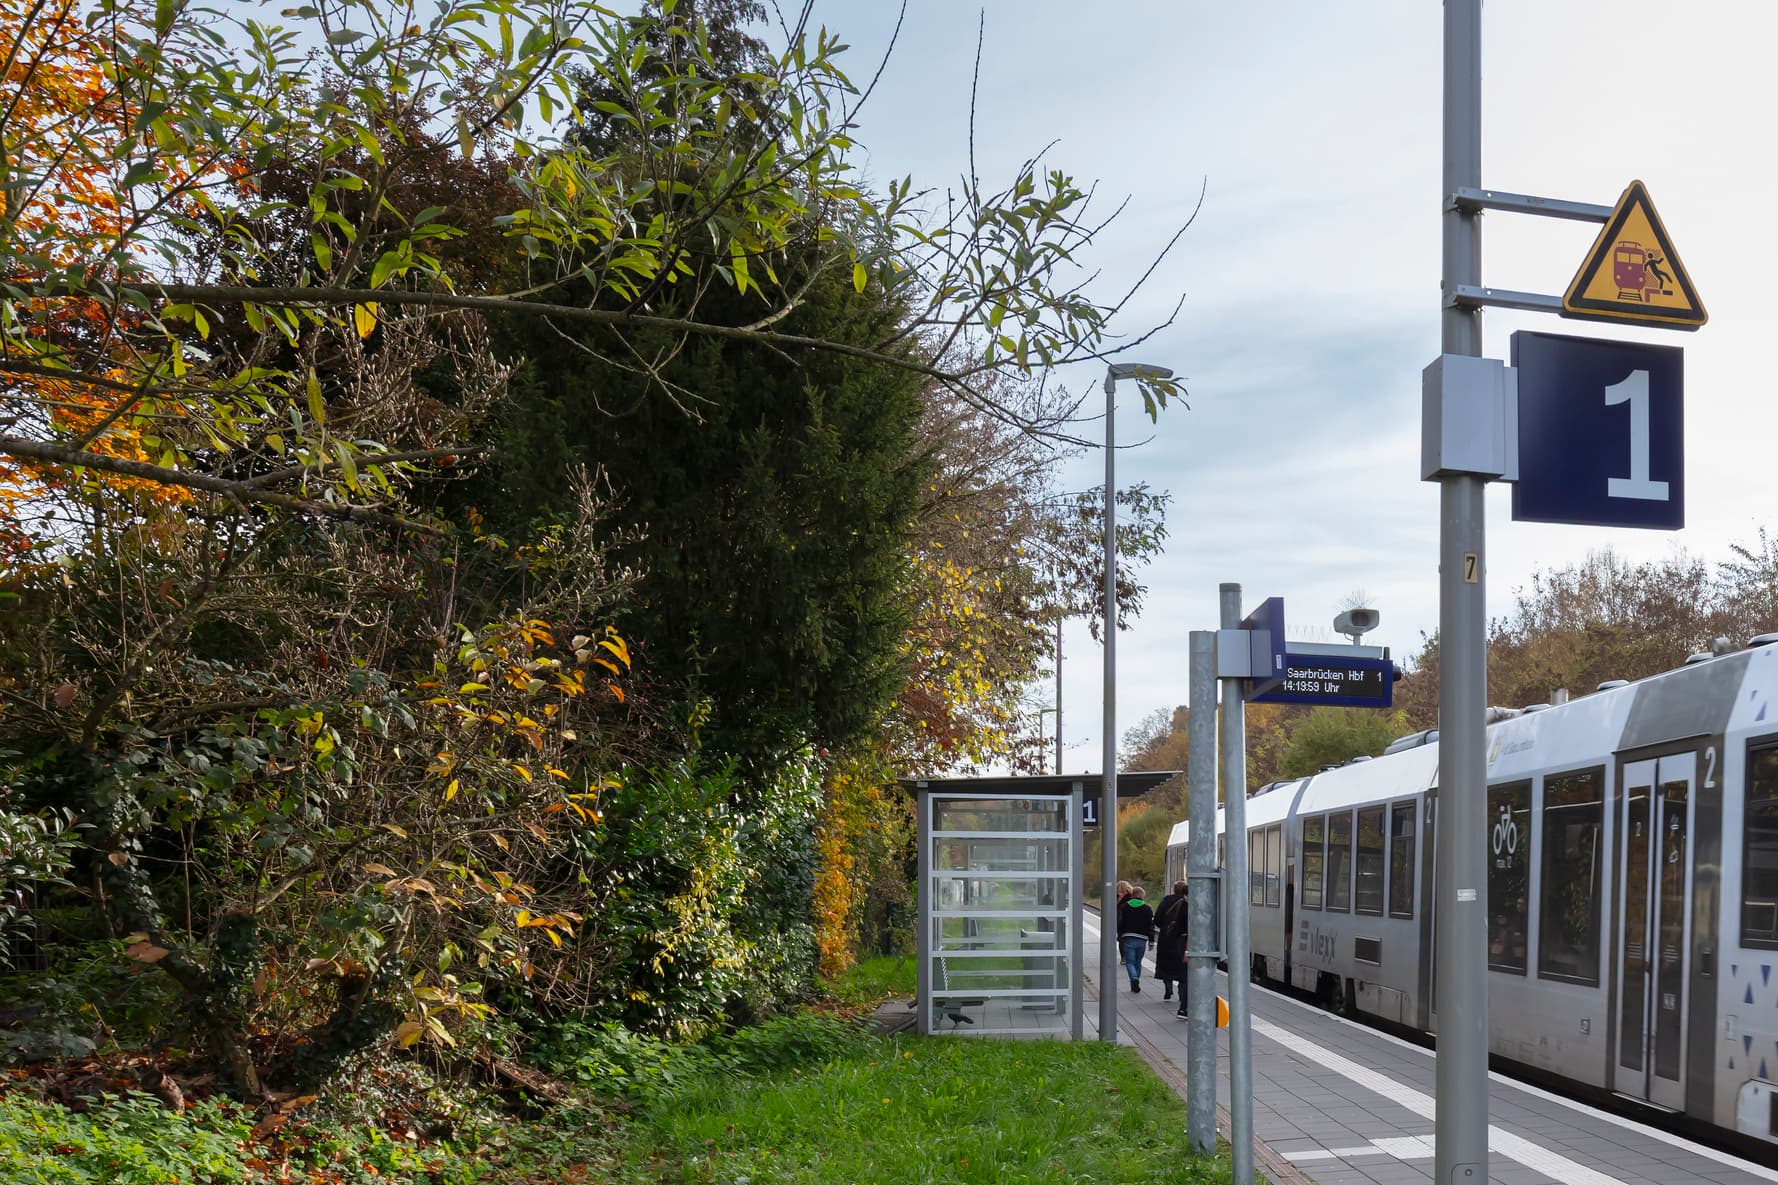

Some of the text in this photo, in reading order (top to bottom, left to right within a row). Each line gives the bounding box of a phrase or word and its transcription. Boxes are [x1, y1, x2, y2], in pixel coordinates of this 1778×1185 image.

[1604, 369, 1670, 501] 1
[1466, 556, 1476, 580] 7
[1282, 680, 1340, 693] 14:19:59 Uhr
[1287, 667, 1382, 682] Saarbrücken Hbf 1
[1704, 746, 1717, 788] 2
[1083, 800, 1096, 823] 1
[1425, 797, 1432, 823] 2
[1310, 928, 1336, 964] vlexx
